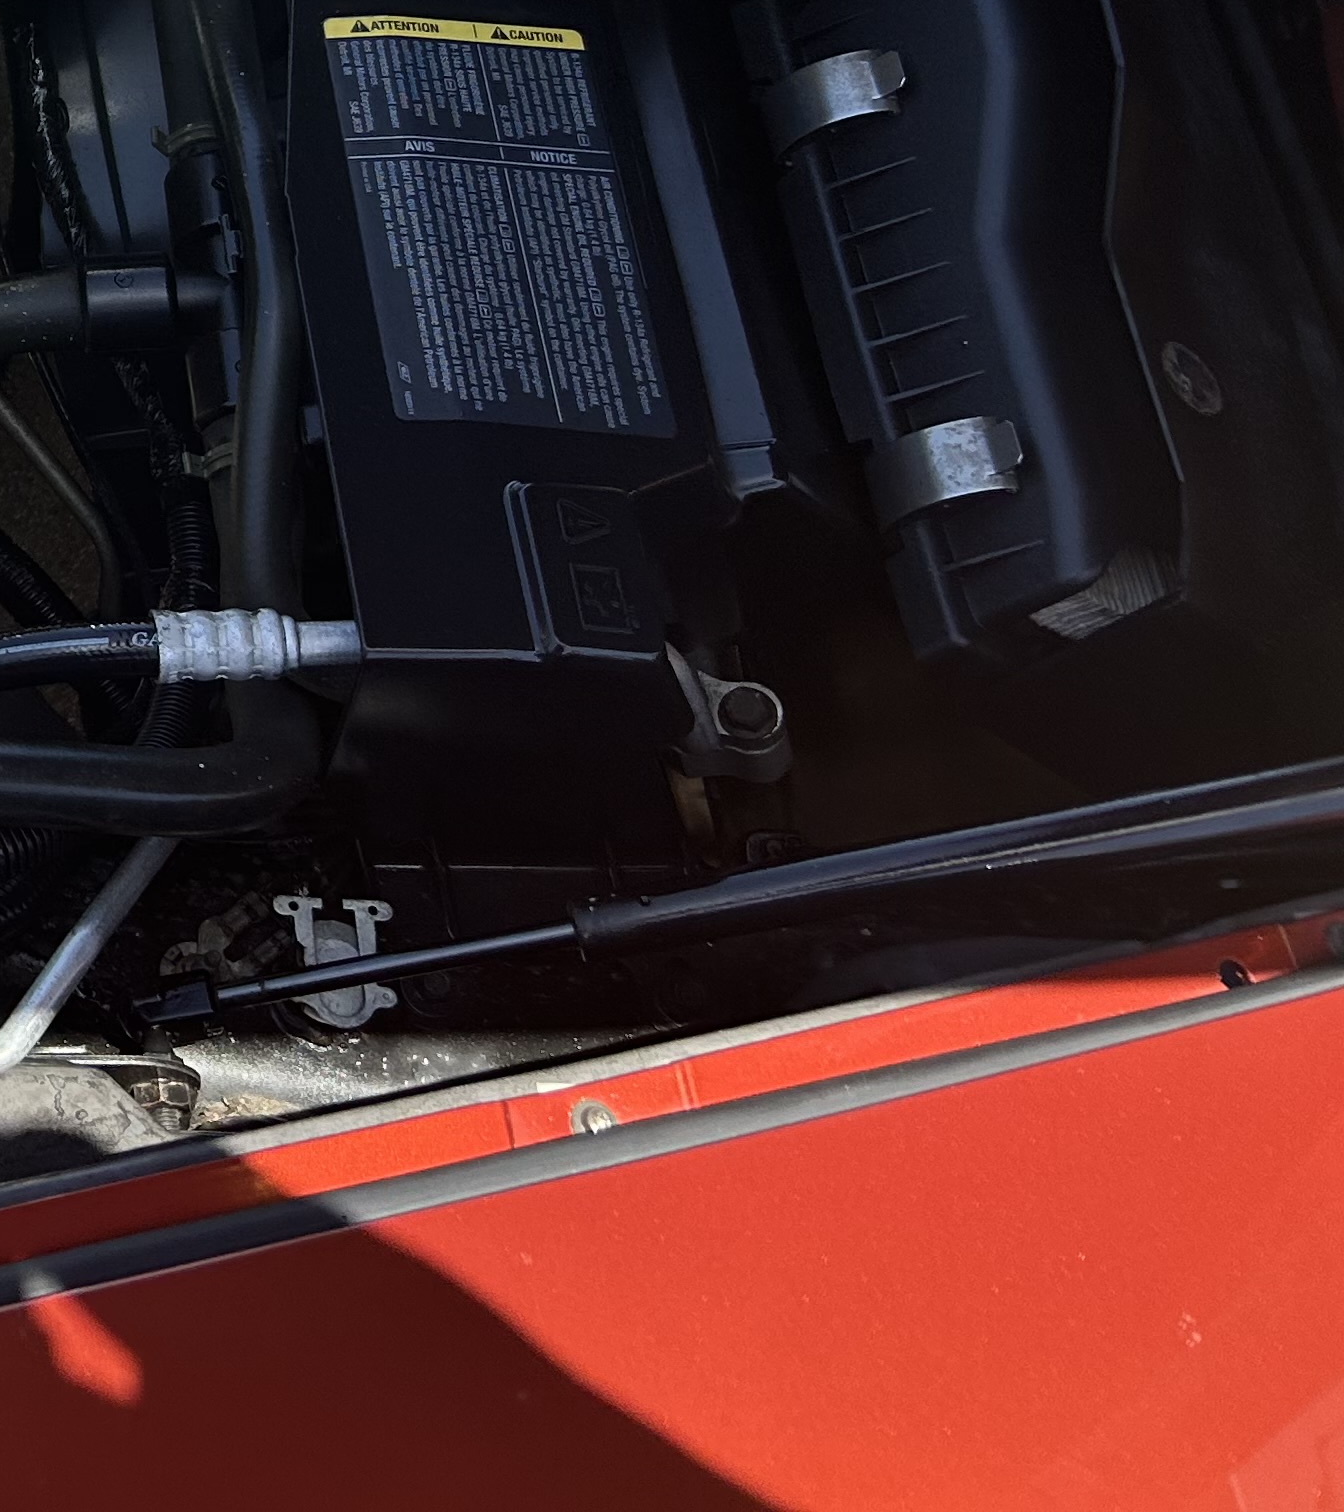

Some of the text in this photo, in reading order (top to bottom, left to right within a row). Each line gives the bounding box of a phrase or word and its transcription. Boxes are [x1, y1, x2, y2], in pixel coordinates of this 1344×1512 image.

[370, 20, 439, 34] ATTENTION
[509, 29, 563, 44] CAUTION
[404, 140, 435, 153] AVIS
[530, 151, 577, 166] NOTICE
